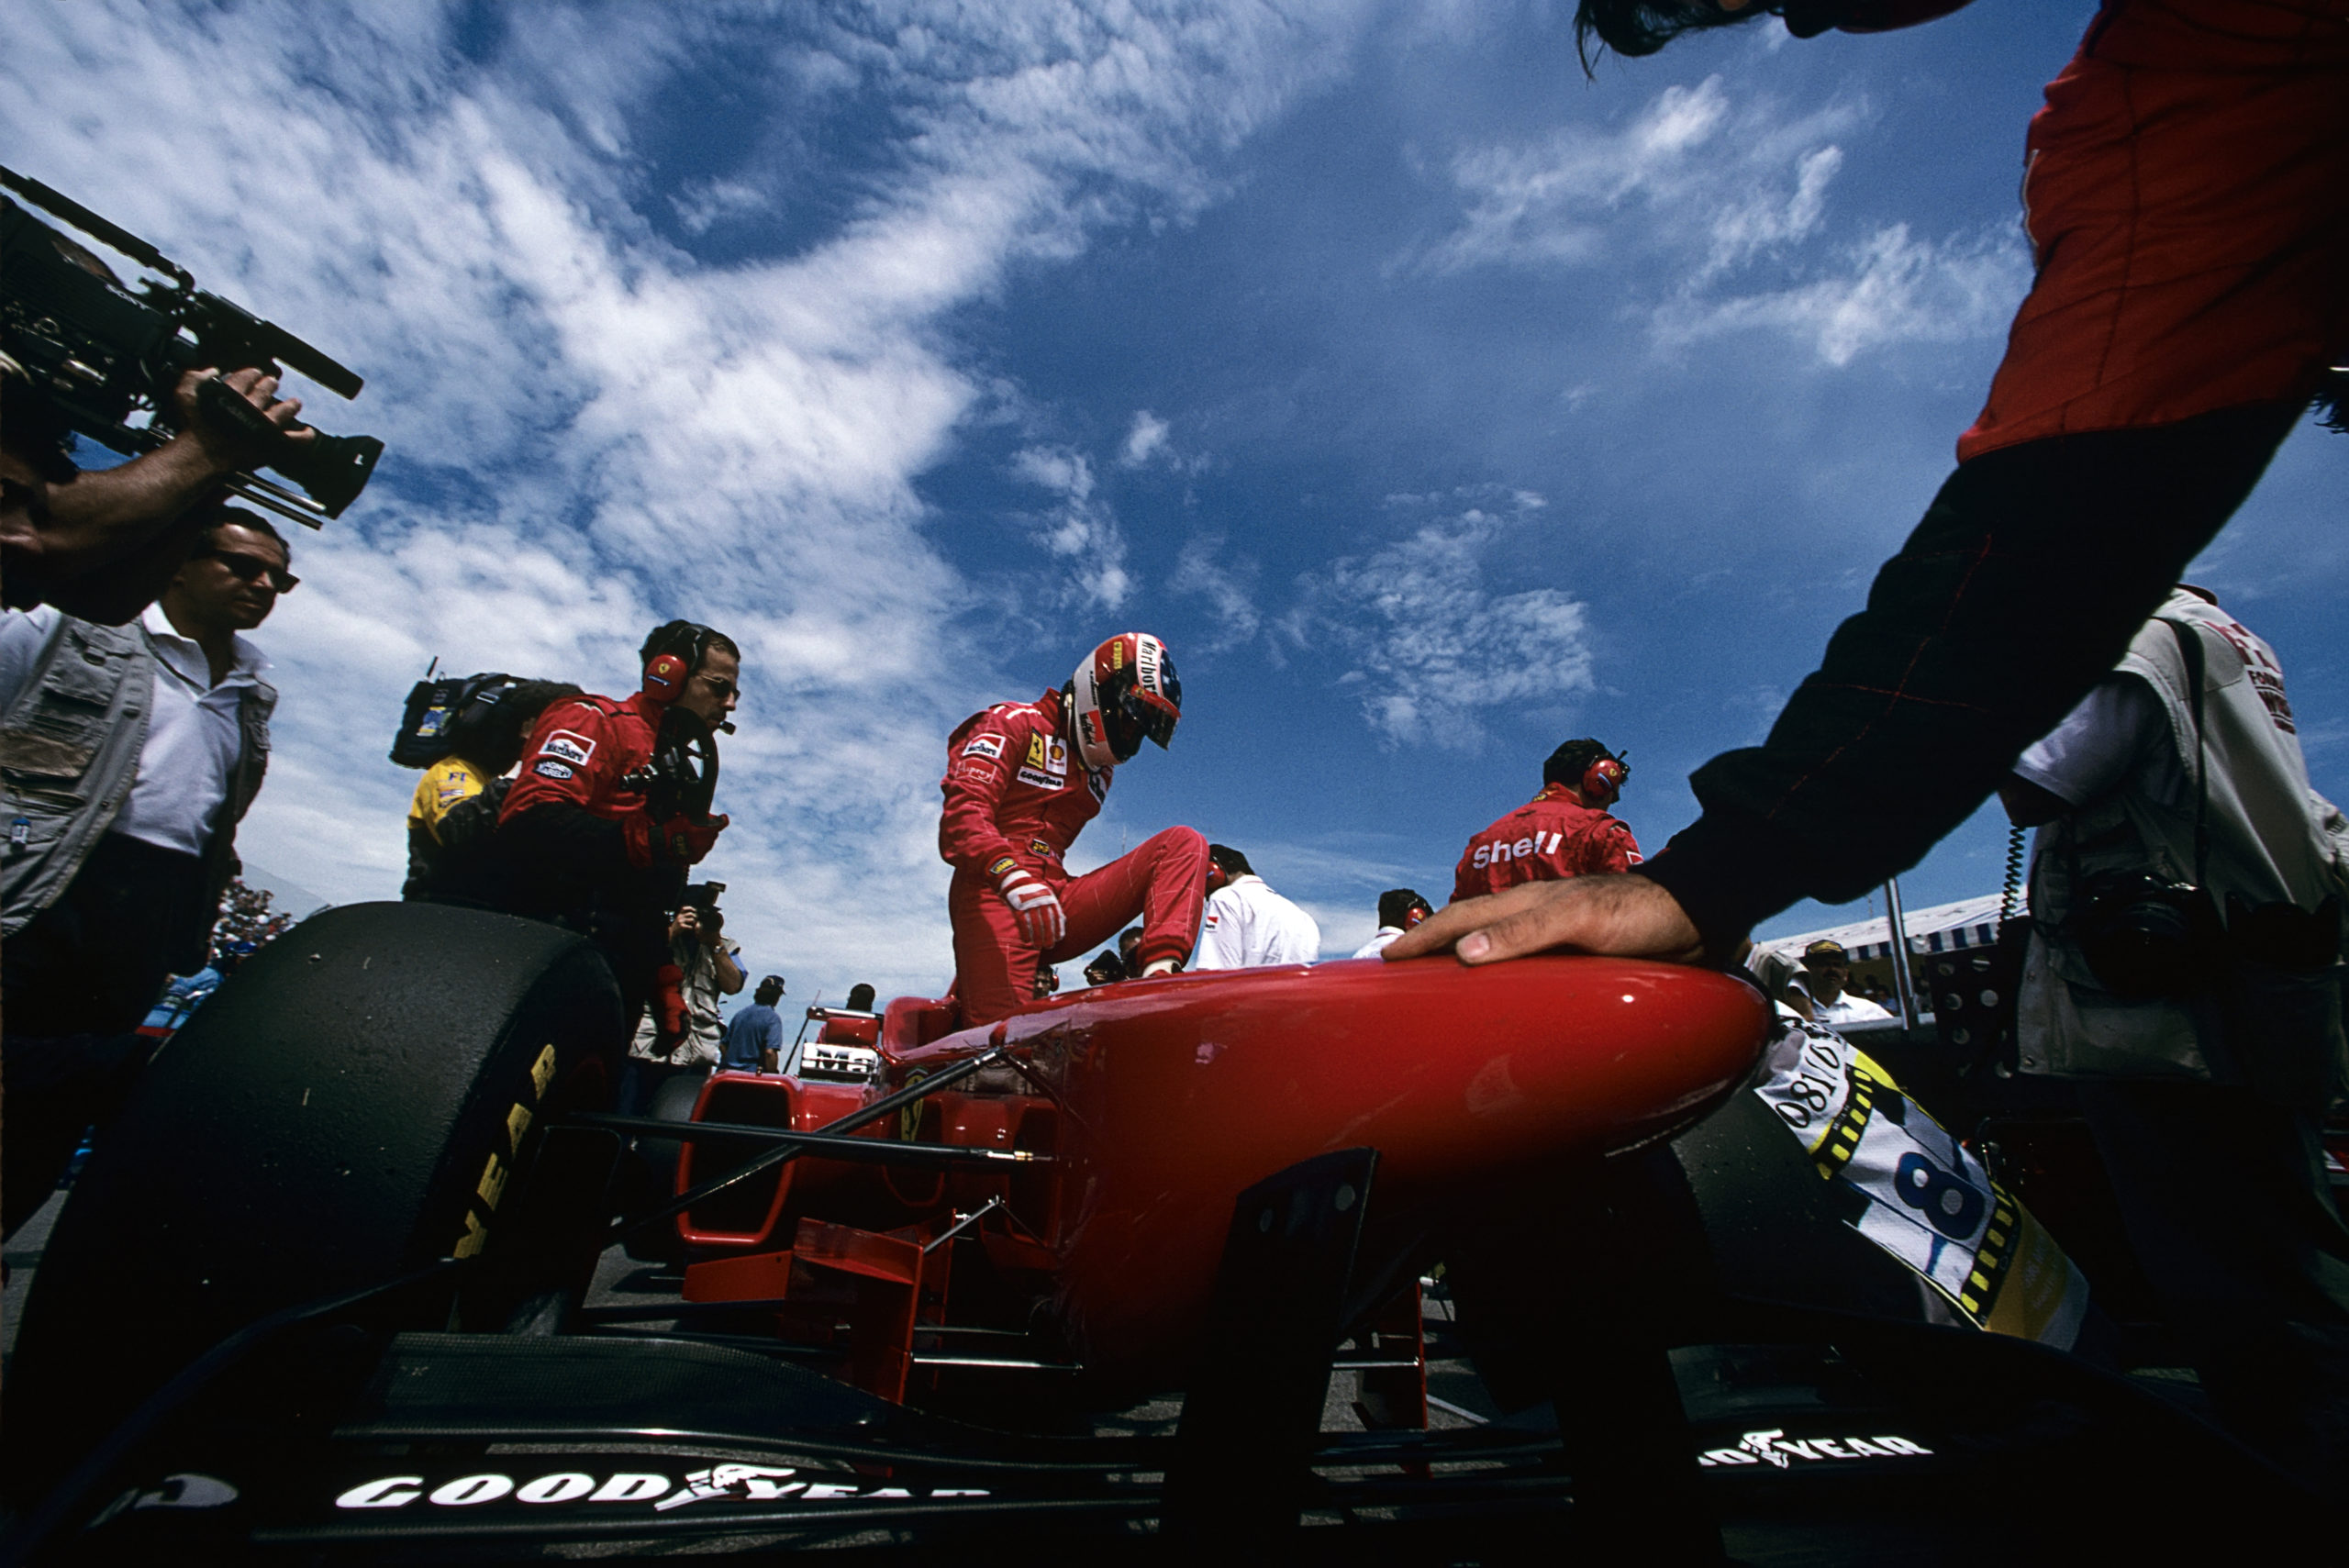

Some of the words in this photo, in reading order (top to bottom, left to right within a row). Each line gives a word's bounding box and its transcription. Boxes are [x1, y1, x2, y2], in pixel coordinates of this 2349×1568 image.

[453, 1044, 557, 1259] YEAR
[1894, 1151, 1986, 1240] 8
[1774, 1436, 1934, 1460] YEAR
[334, 1473, 670, 1508] GOOD
